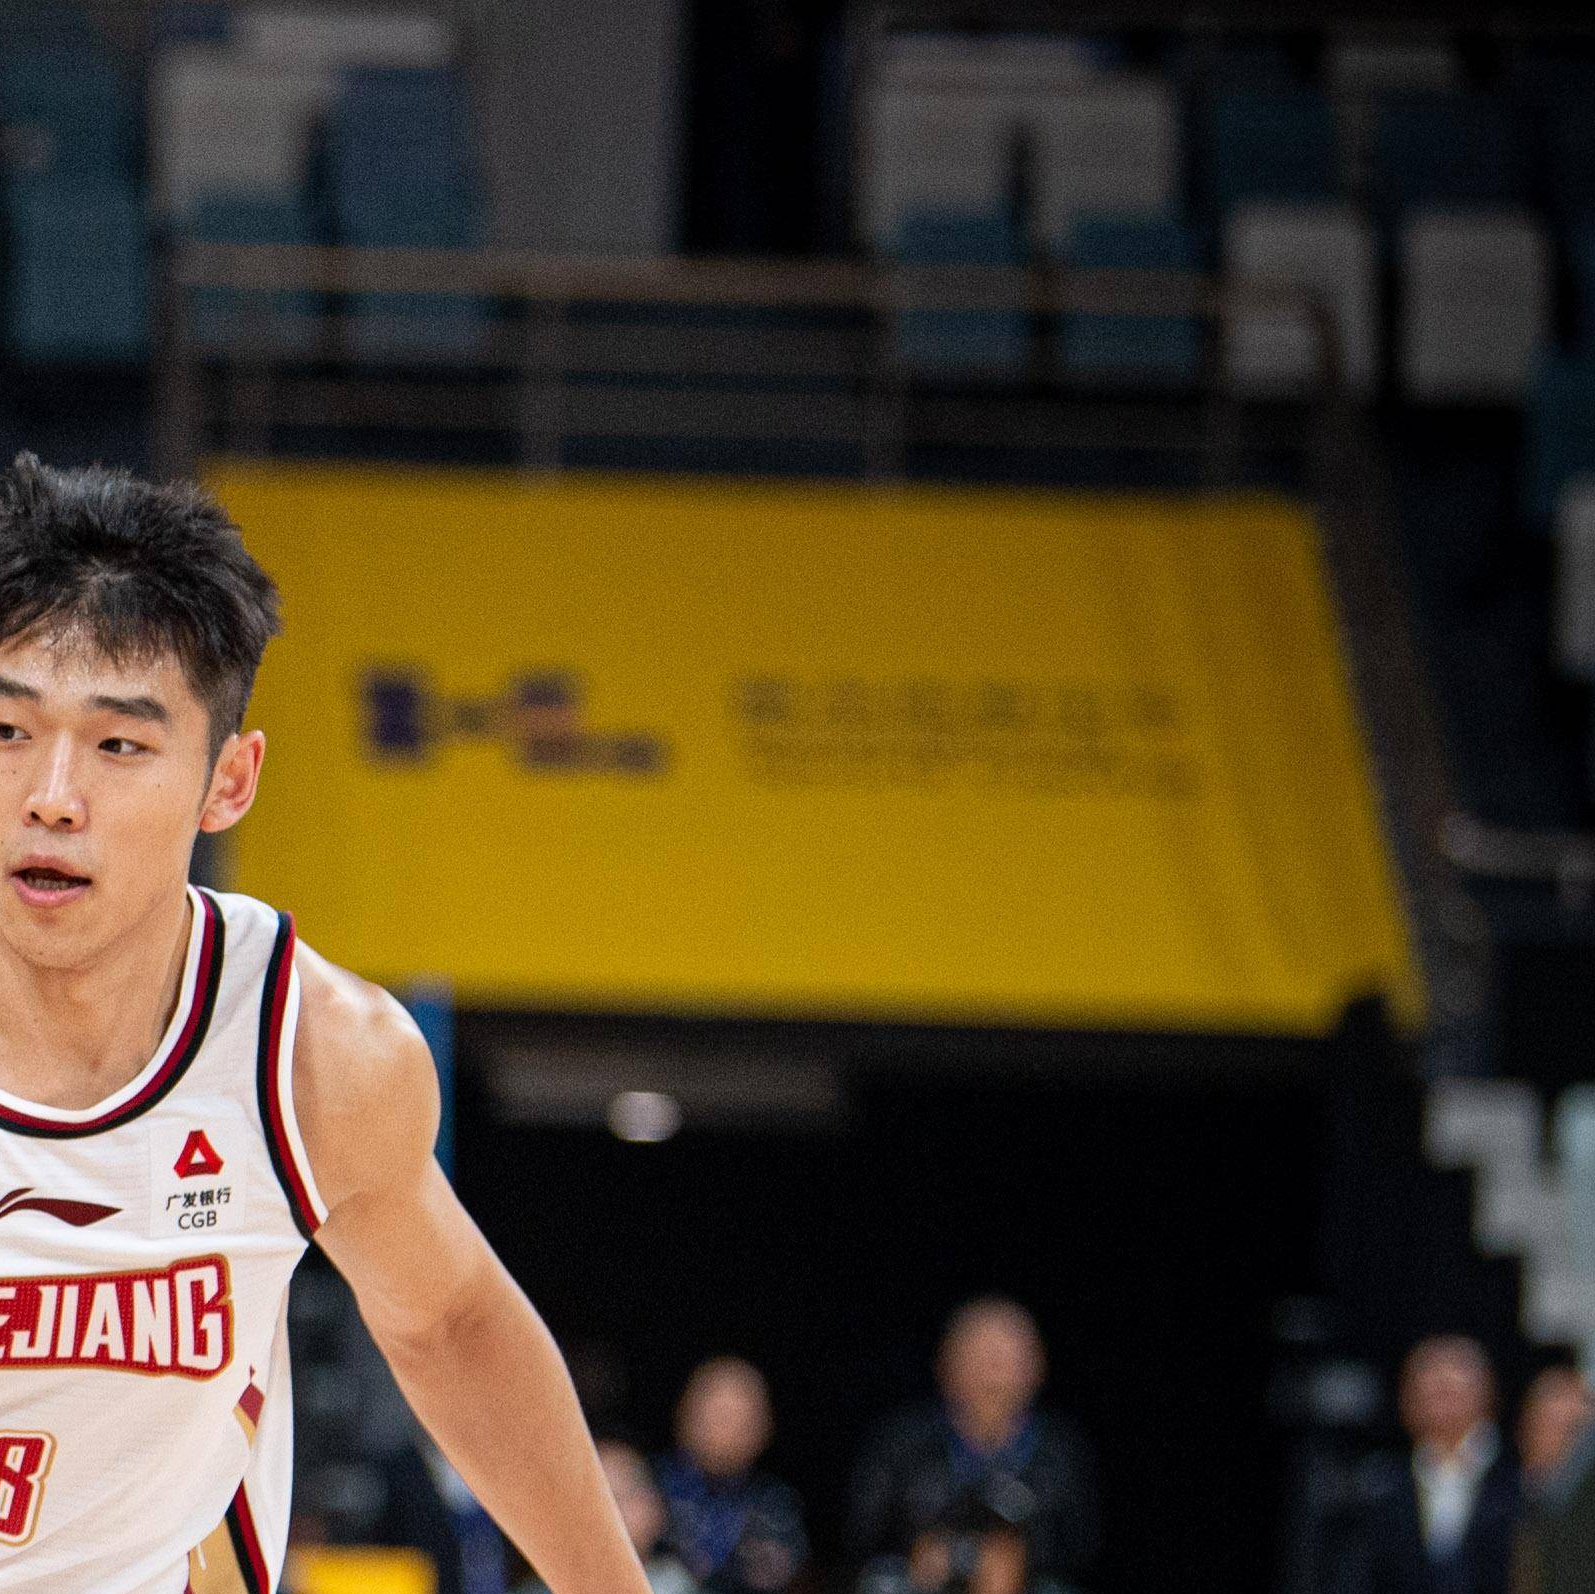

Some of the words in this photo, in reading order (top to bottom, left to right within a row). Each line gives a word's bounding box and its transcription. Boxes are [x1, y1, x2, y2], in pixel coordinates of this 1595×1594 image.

[165, 1186, 231, 1211] 广发银行
[177, 1210, 218, 1230] CGB
